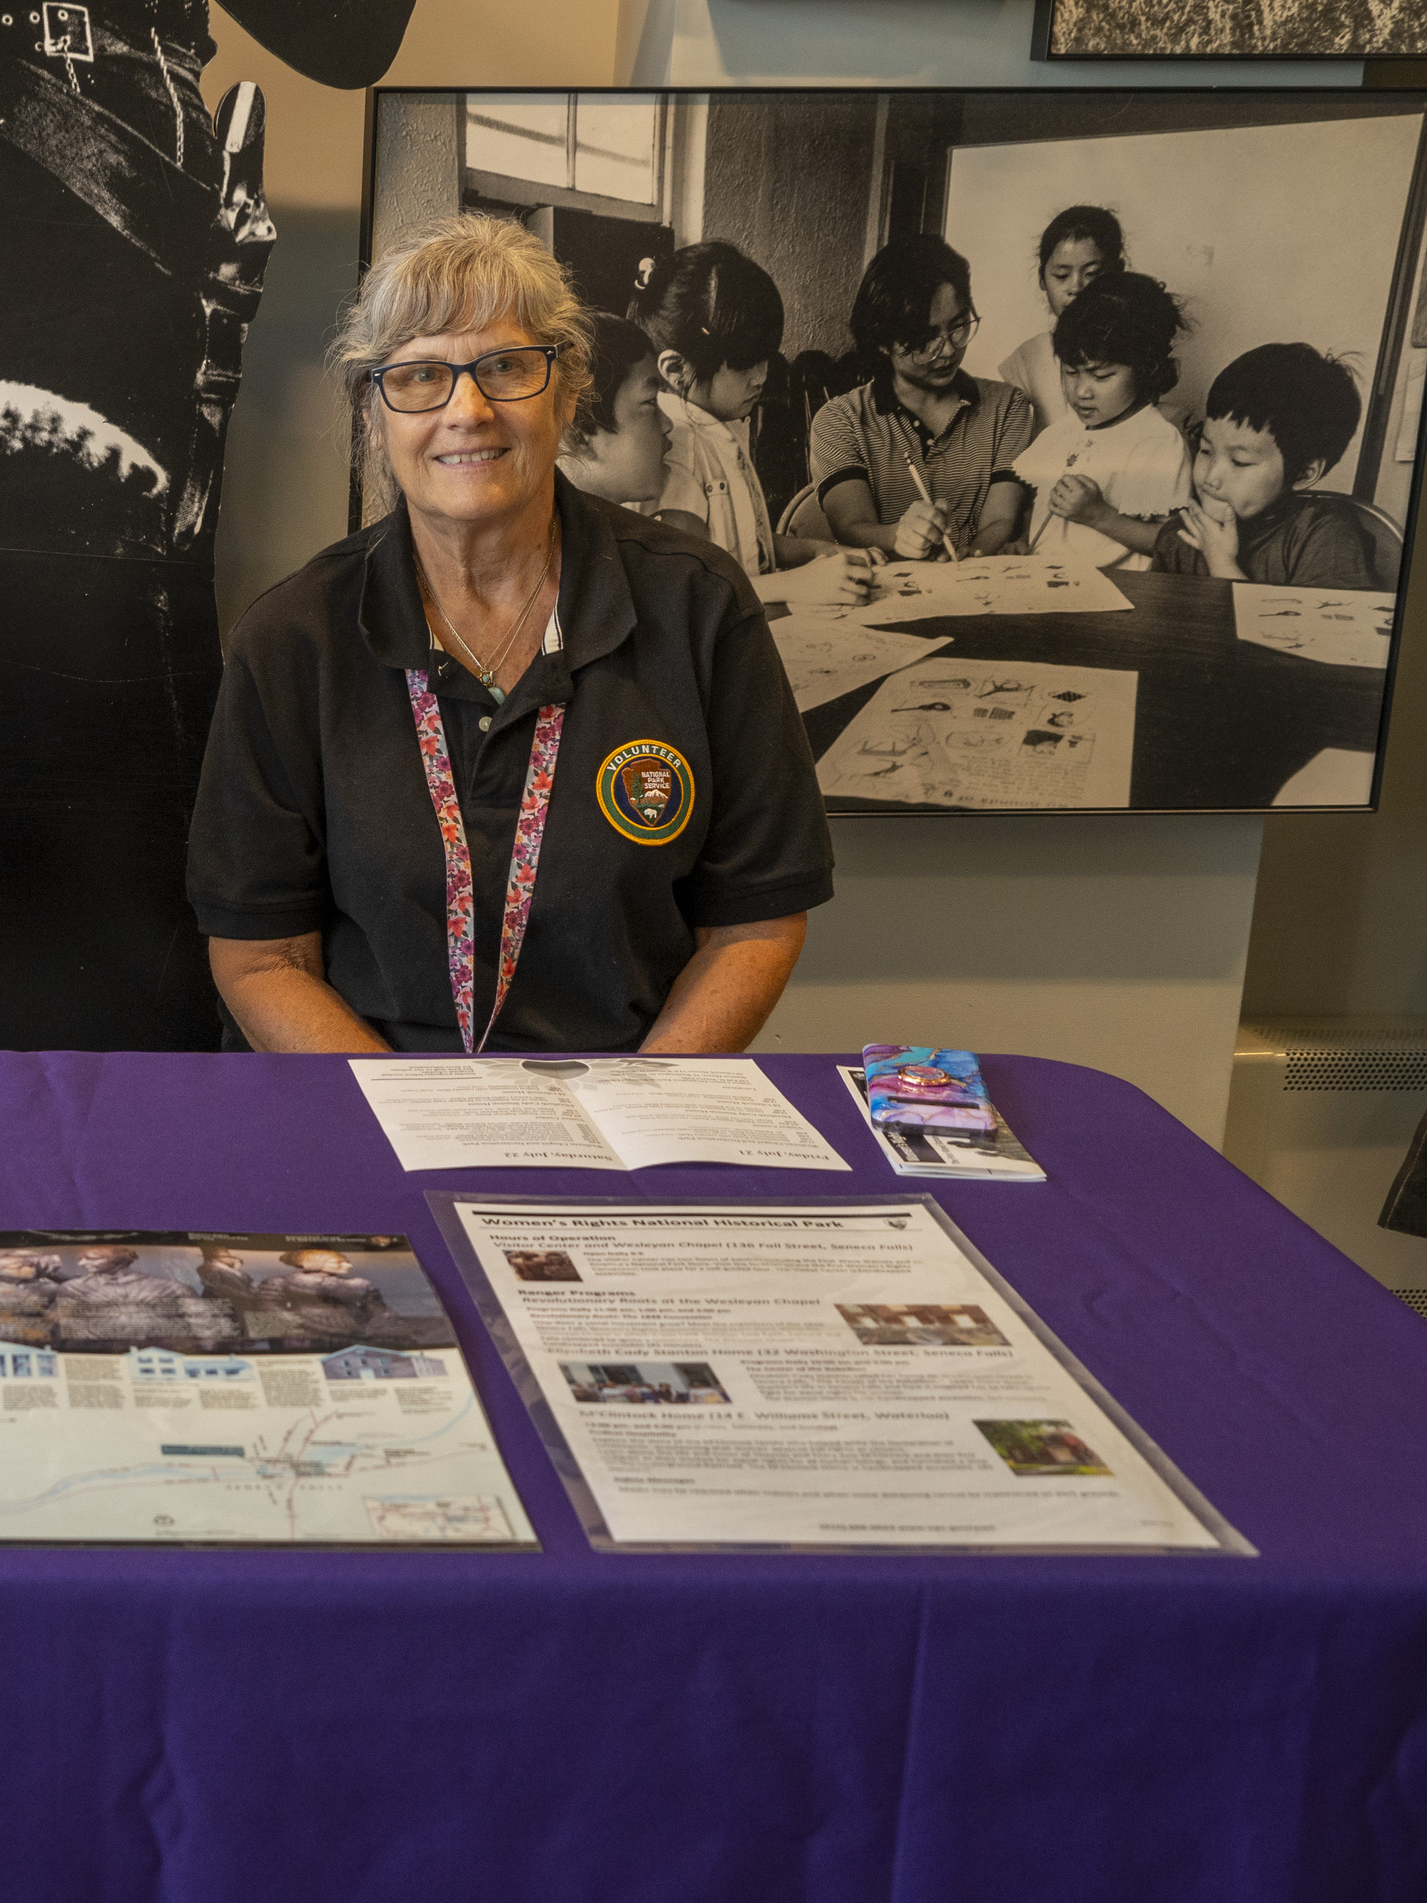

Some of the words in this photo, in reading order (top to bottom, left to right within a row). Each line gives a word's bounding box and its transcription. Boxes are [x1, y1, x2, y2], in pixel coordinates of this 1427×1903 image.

[606, 744, 682, 771] VOLUNTEER
[551, 1152, 613, 1162] Saturday,
[783, 1151, 830, 1160] Friday,
[481, 1218, 567, 1226] Women's
[572, 1219, 627, 1228] Rights
[713, 1219, 798, 1227] Historical
